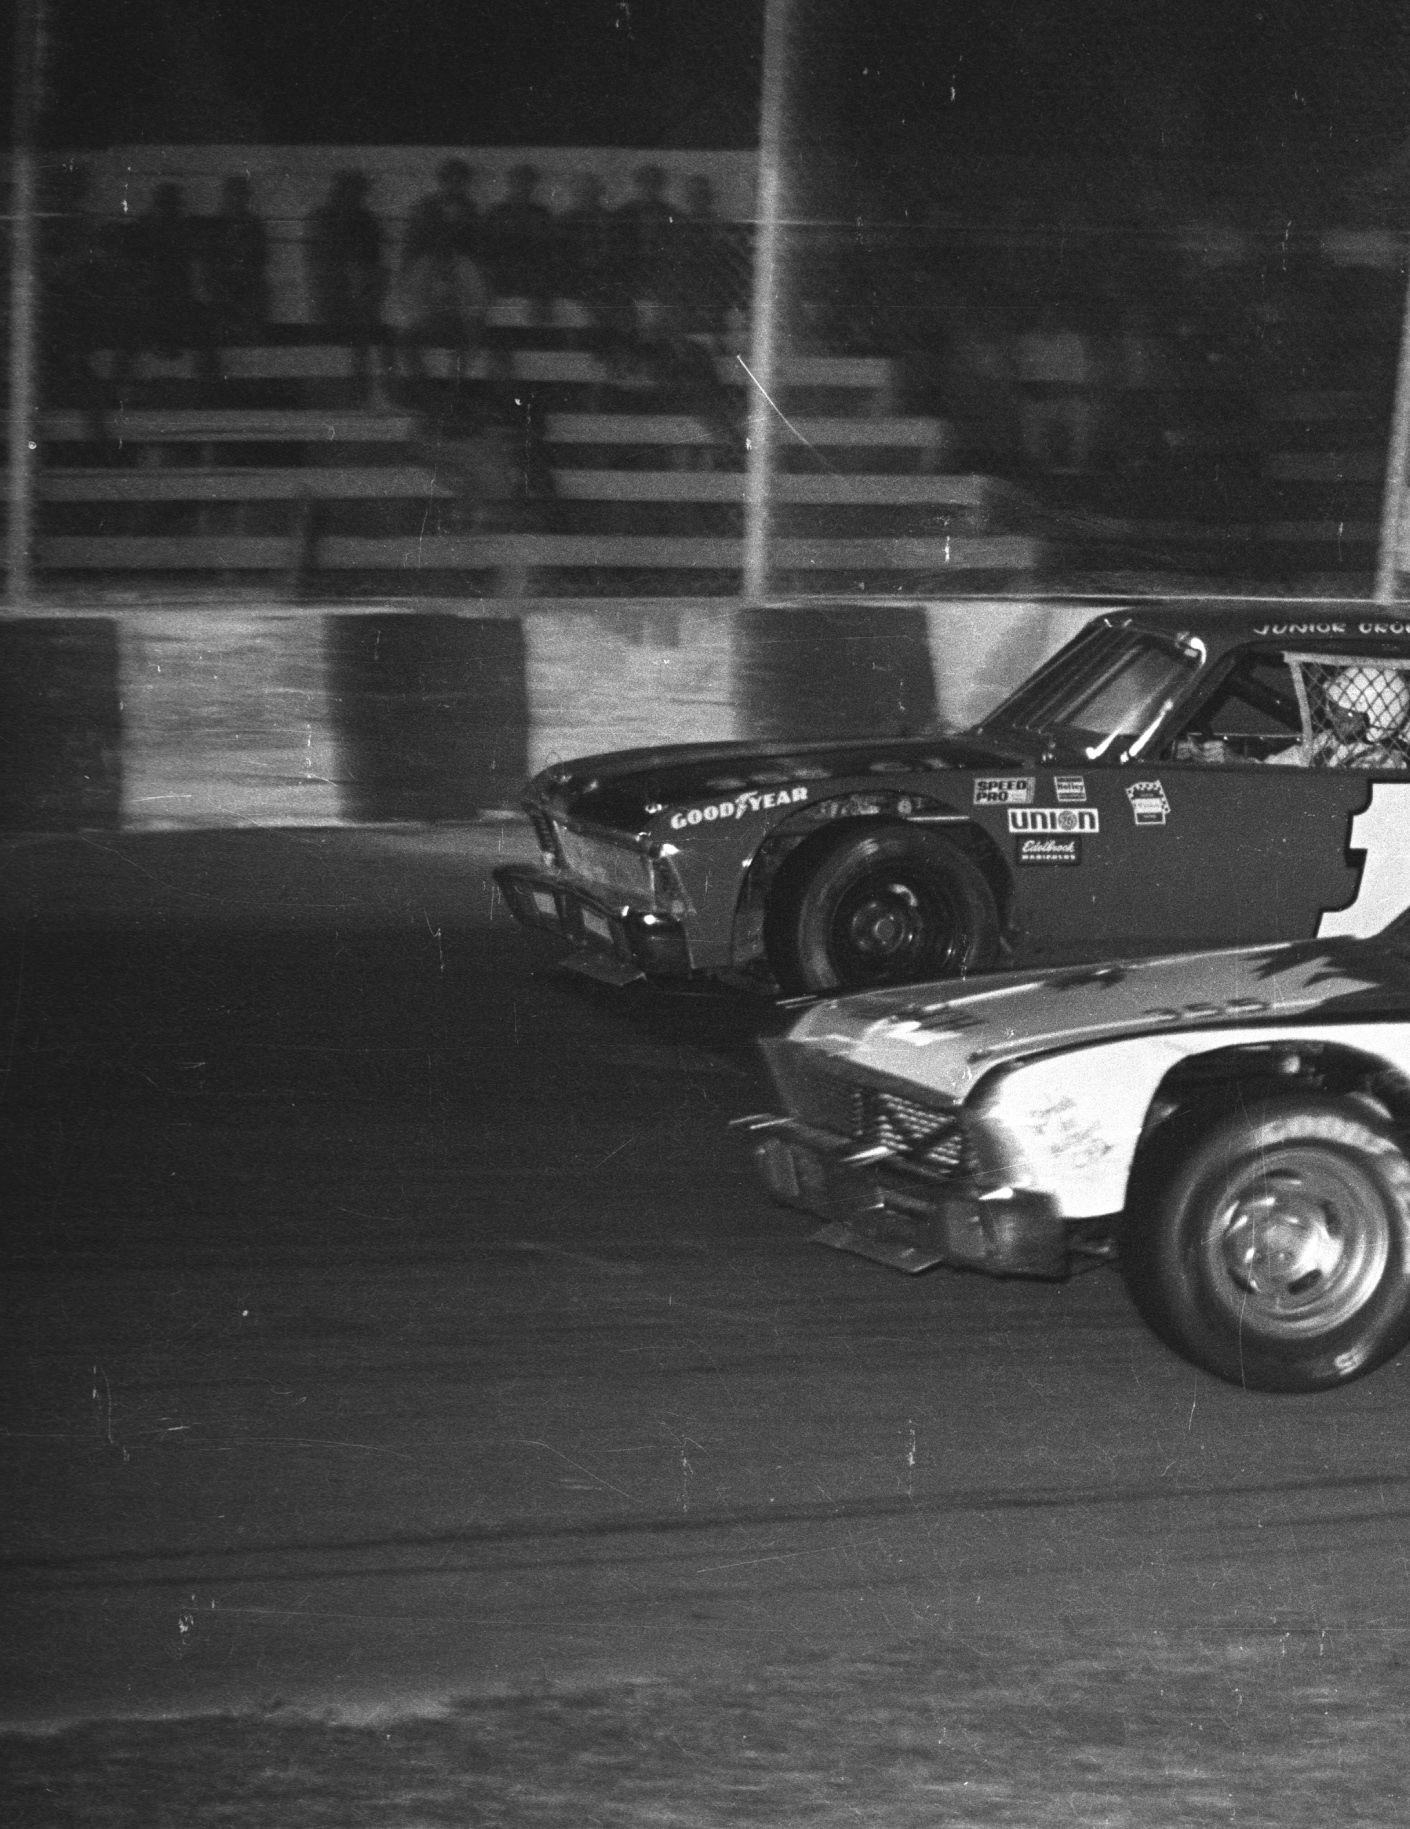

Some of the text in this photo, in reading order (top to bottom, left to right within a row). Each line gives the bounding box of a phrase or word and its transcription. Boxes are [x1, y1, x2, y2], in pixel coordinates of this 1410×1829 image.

[1253, 622, 1347, 636] JUNIOR
[977, 781, 1028, 791] SPEED
[975, 792, 1008, 802] PRO
[670, 786, 808, 829] GOODYEAR
